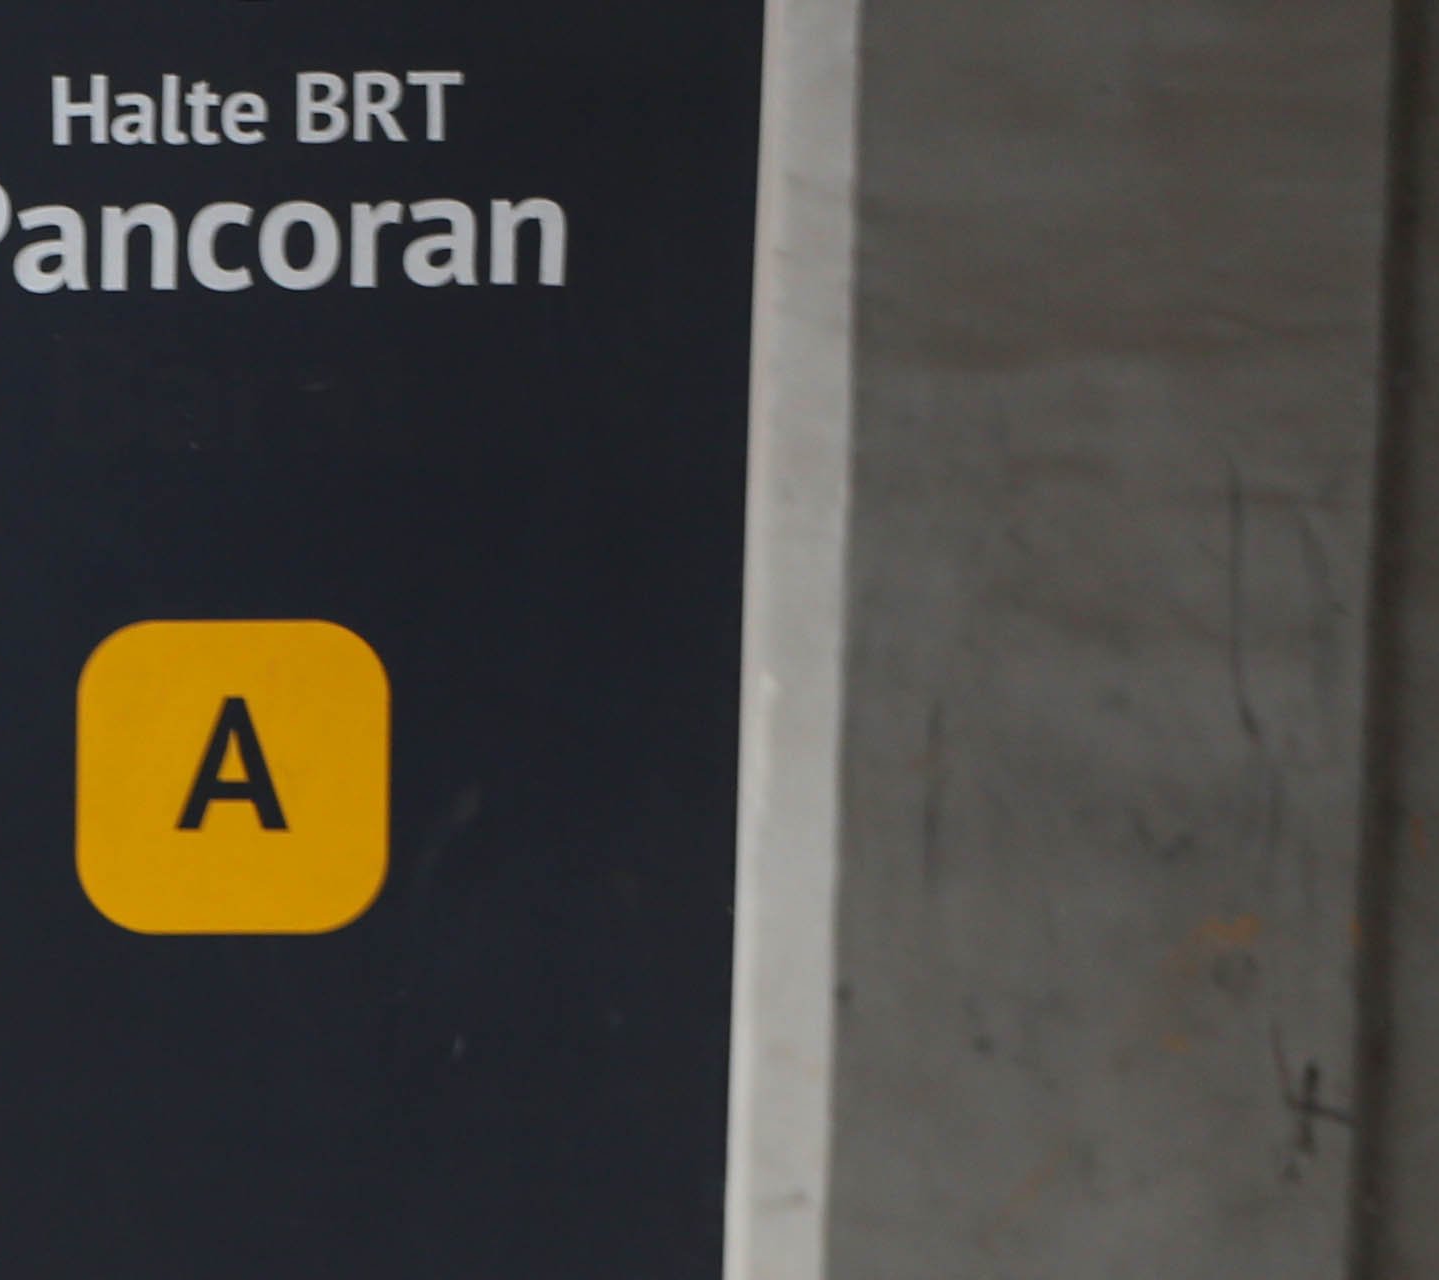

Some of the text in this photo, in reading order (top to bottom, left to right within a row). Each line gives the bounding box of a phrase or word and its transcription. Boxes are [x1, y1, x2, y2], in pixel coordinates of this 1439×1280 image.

[51, 70, 465, 146] Halte BRT
[176, 697, 290, 831] A
